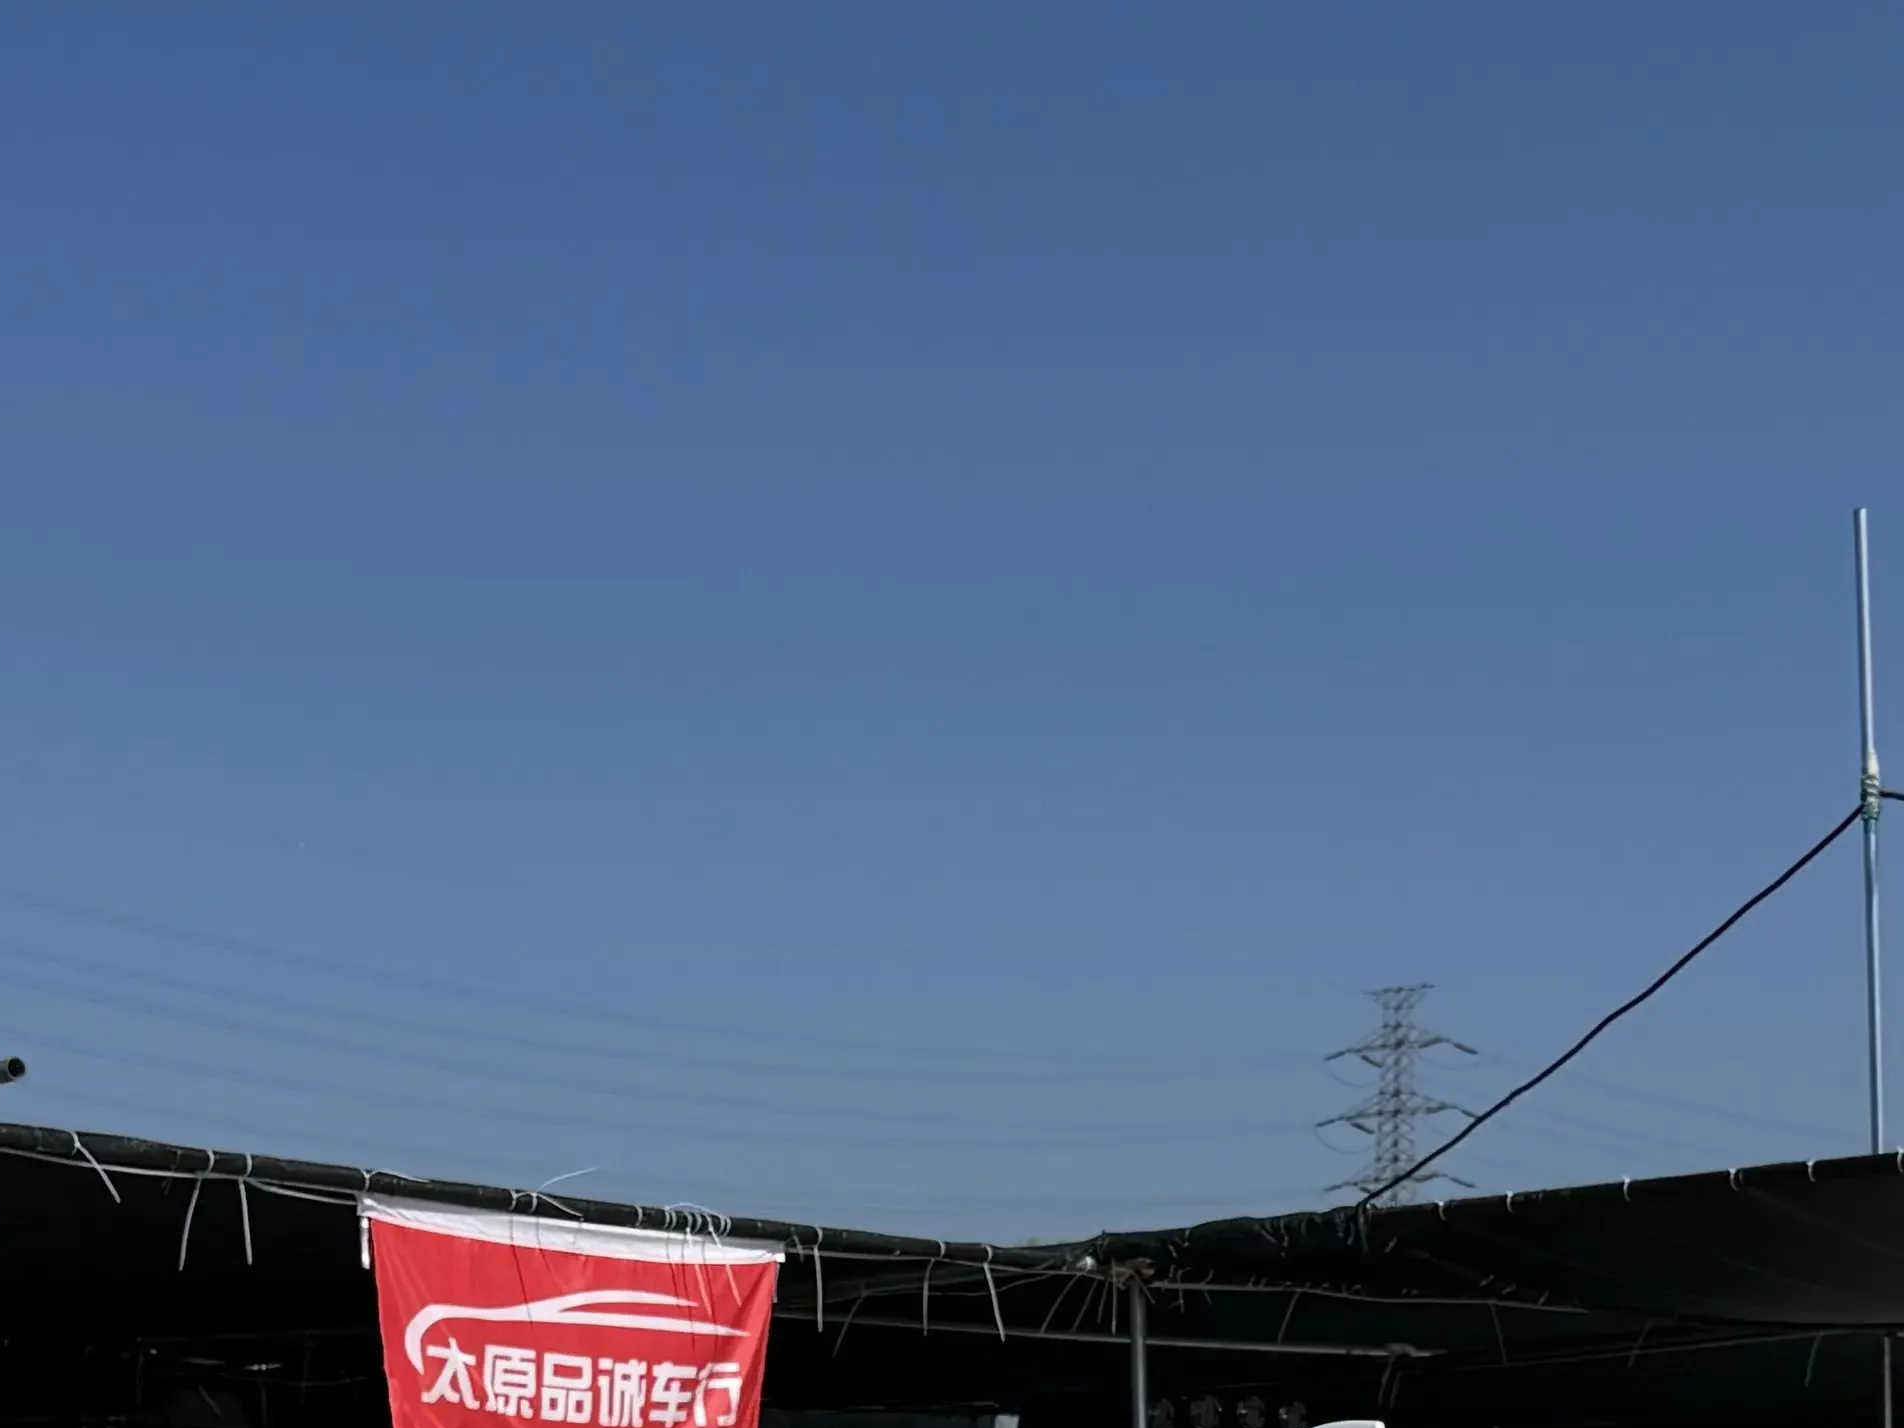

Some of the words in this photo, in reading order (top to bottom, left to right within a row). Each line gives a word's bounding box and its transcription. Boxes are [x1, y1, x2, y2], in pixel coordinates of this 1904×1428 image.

[421, 1336, 743, 1428] 太原品诚车行
